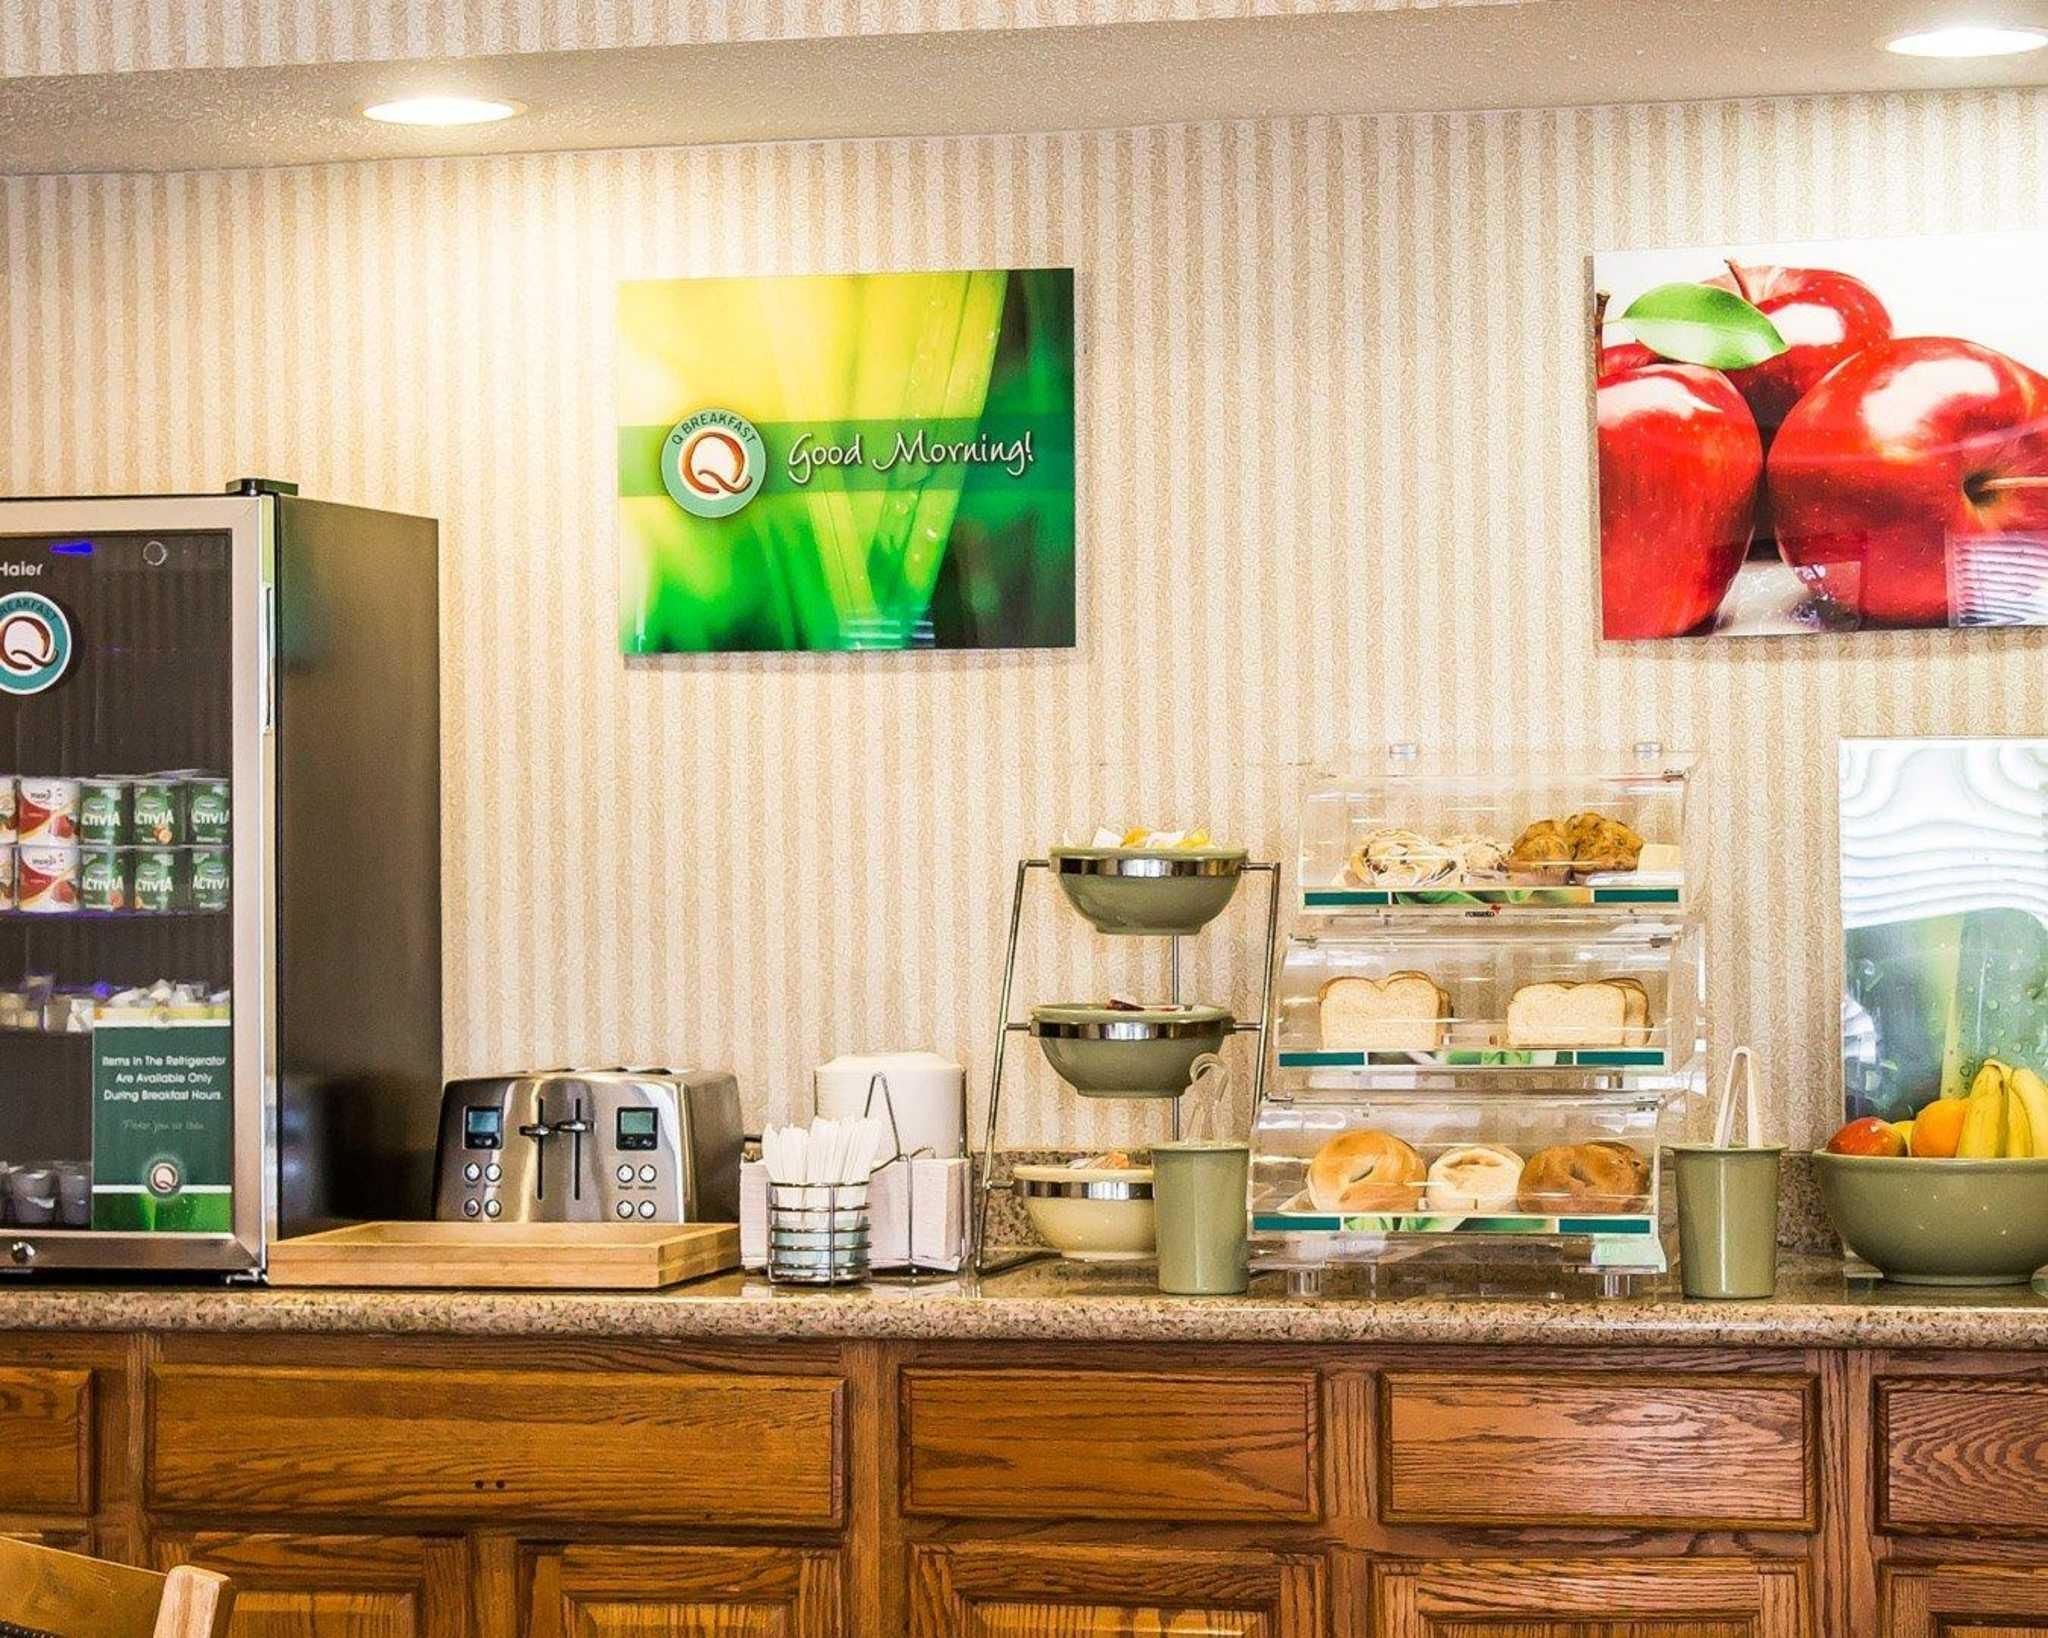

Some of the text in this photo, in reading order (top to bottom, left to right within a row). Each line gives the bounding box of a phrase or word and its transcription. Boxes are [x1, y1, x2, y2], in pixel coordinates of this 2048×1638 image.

[671, 412, 757, 445] Q BREAKFAST
[681, 431, 753, 495] Q
[786, 429, 1034, 485] Good Morning!
[102, 1055, 226, 1069] Items In The Refrigerator
[115, 1072, 213, 1085] Are Available Only
[103, 1089, 139, 1103] During
[141, 1090, 190, 1101] Breakfast
